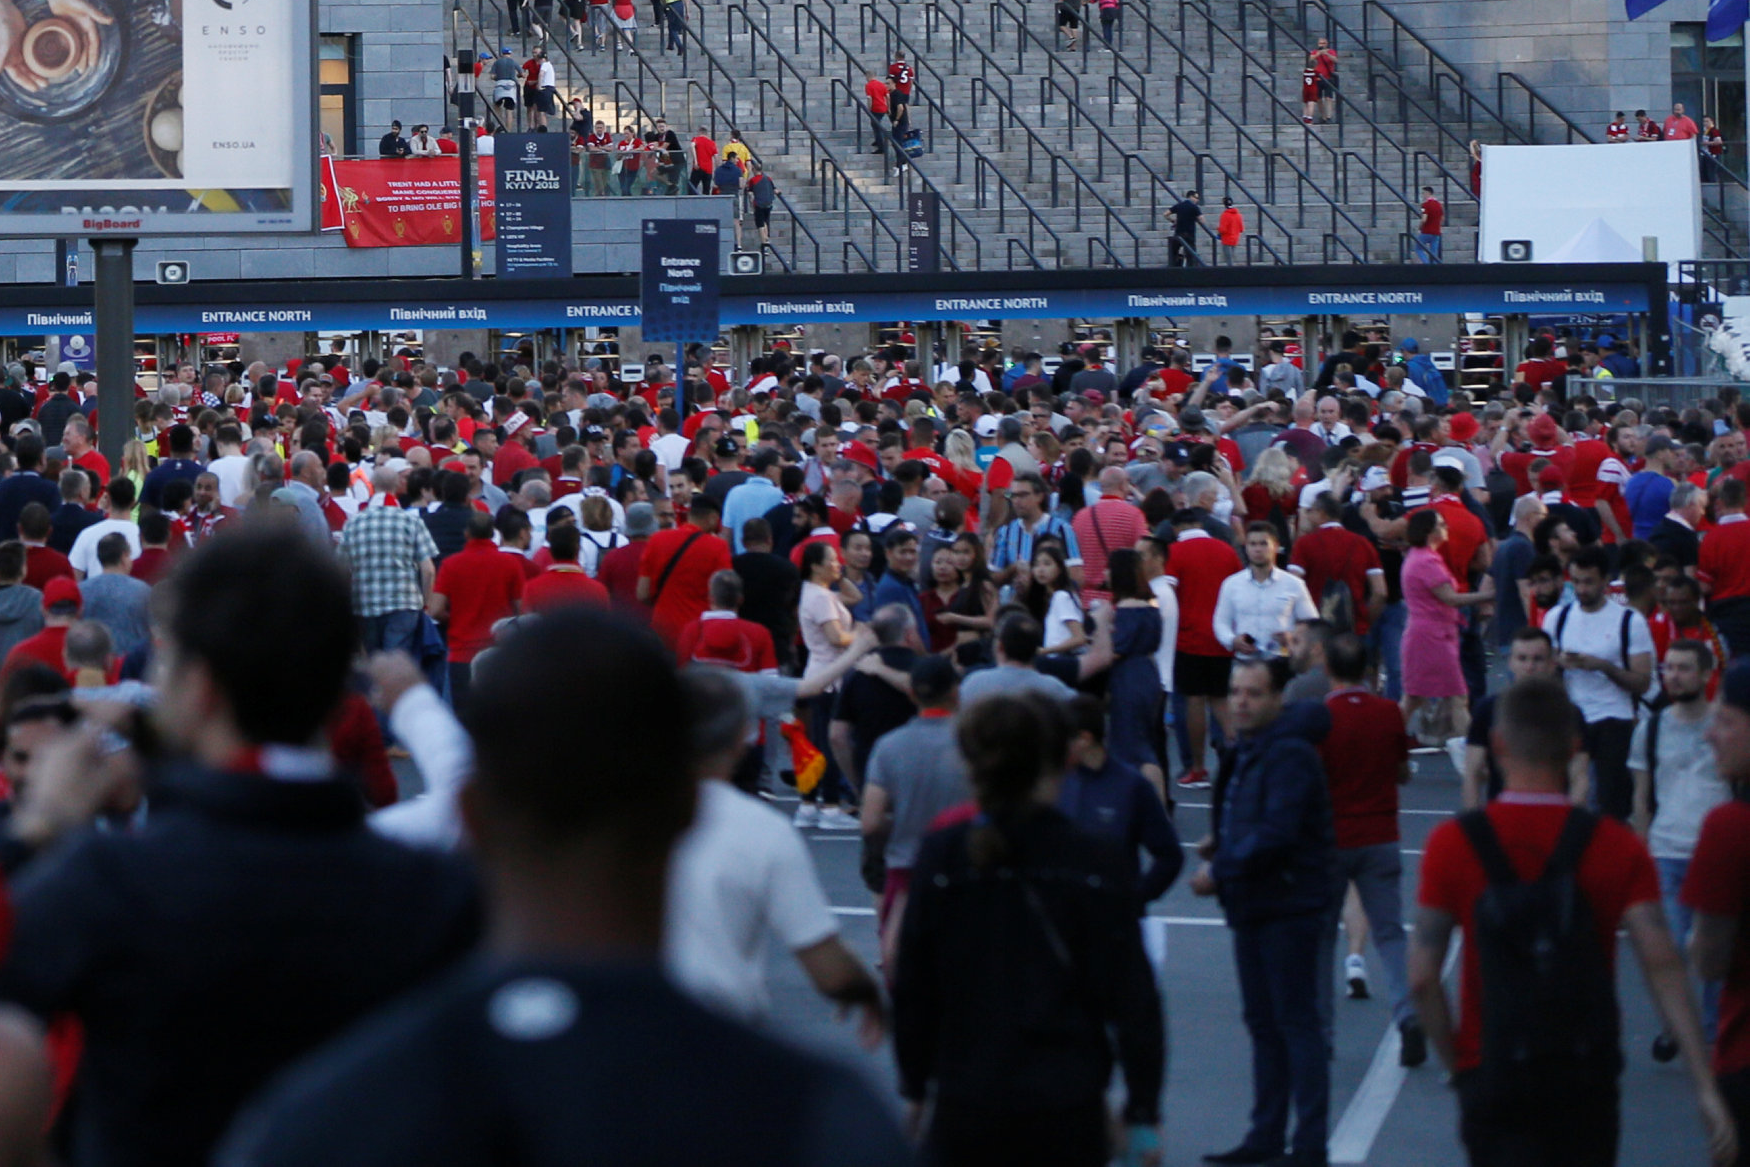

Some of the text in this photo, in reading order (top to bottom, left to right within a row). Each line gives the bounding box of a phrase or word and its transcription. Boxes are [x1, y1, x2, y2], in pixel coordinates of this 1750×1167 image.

[203, 26, 266, 35] ENSO
[900, 70, 908, 83] 5
[212, 141, 255, 149] ENSO.UA
[504, 170, 560, 181] FINAL
[505, 181, 560, 190] KYIV 2018
[388, 205, 399, 213] TO
[400, 204, 425, 212] BRING
[83, 218, 140, 230] BigBoard
[661, 257, 701, 266] Entrance
[667, 269, 694, 277] North
[1128, 293, 1227, 308] Північний вхід
[1308, 292, 1423, 304] ENTRANCE NORTH
[1504, 289, 1605, 304] Північний вхід
[756, 300, 855, 315] Північний вхід
[935, 298, 1048, 310] ENTRANCE NORTH
[202, 310, 311, 322] ENTRANCE NORTH
[390, 305, 487, 321] Північний вхід
[567, 305, 631, 317] ENTRANCE
[27, 311, 92, 325] Північний
